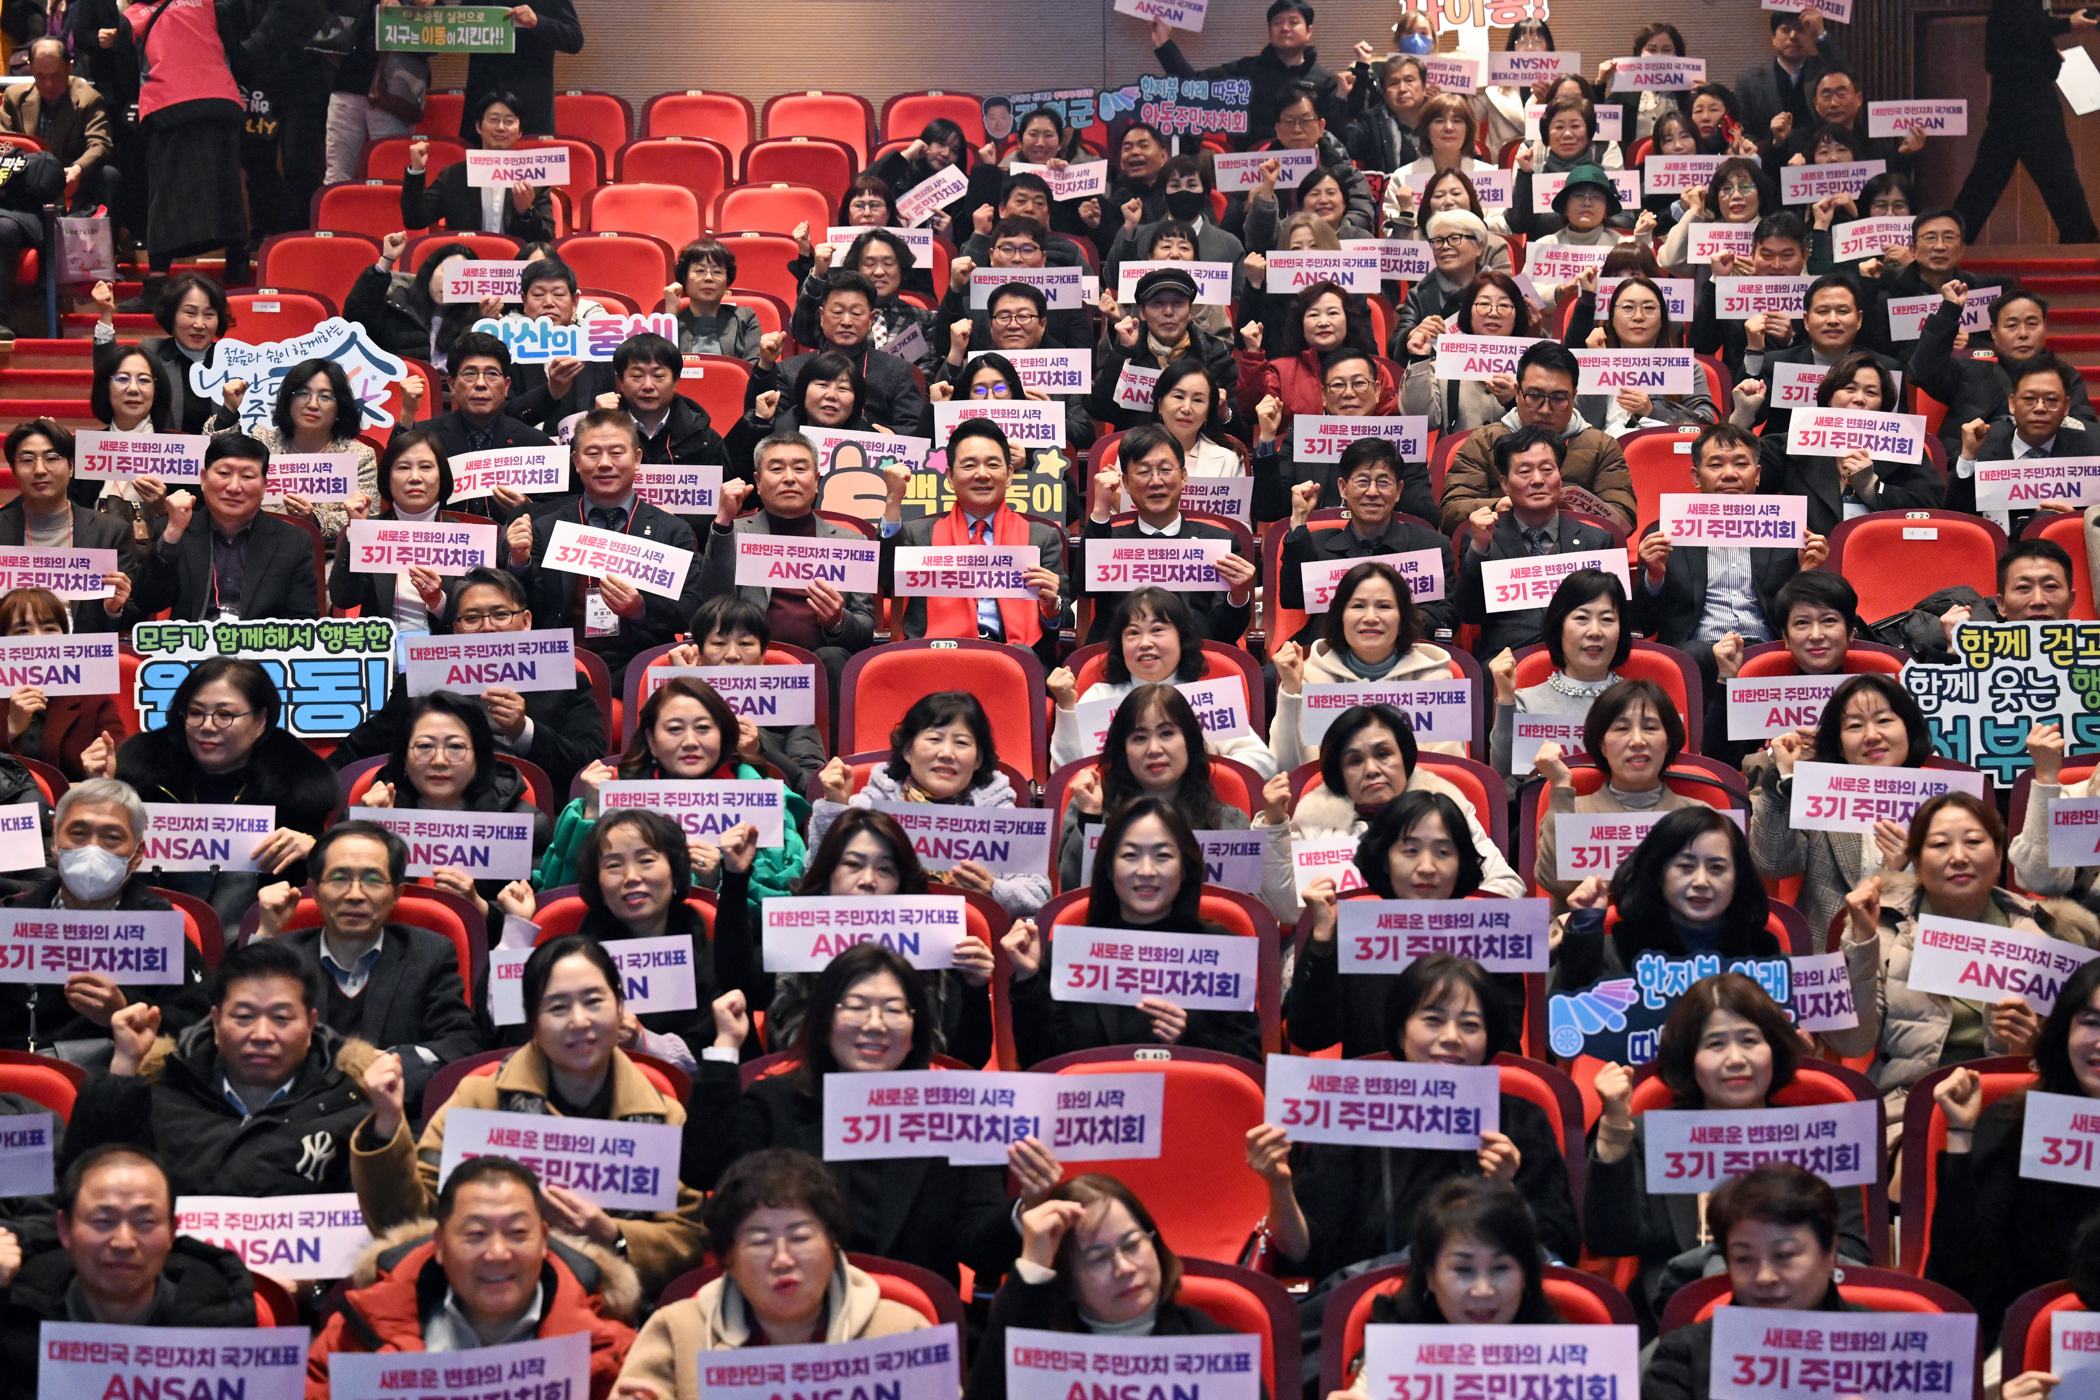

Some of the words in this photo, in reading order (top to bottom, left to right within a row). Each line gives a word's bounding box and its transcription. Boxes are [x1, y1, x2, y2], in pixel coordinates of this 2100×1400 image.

[1135, 2, 1184, 21] ANSAN
[385, 25, 420, 45] 지구는
[421, 26, 456, 46] 이동이
[457, 27, 504, 46] 지킨다!!
[1510, 58, 1560, 69] ANSAN
[1617, 63, 1643, 71] 대한민국
[1644, 63, 1672, 71] 주민자치
[1674, 63, 1701, 71] 국가대표
[1634, 73, 1684, 86] ANSAN
[1141, 75, 1177, 102] 한지붕
[1181, 80, 1208, 100] 아래
[1211, 79, 1251, 104] 따뜻한
[1141, 102, 1248, 135] 와동주민자치회
[1872, 107, 1902, 116] 대한민국
[1904, 106, 1933, 115] 주민자치
[1935, 106, 1963, 114] 국가대표
[1893, 117, 1944, 130] ANSAN
[470, 157, 501, 165] 대한민국
[503, 157, 533, 166] 주민자치
[535, 155, 566, 164] 국가대표
[492, 167, 545, 181] ANSAN
[1801, 171, 1824, 180] 새로운
[1826, 169, 1849, 179] 변화의
[1851, 168, 1867, 177] 시작
[1790, 183, 1812, 197] 3기
[1270, 259, 1303, 268] 대한민국
[1306, 259, 1340, 268] 주민자치
[1343, 259, 1377, 268] 국가대표
[974, 275, 1007, 285] 대한민국
[1046, 275, 1079, 284] 국가대표
[1292, 272, 1353, 285] ANSAN
[1737, 284, 1763, 294] 새로운
[1765, 284, 1790, 294] 변화의
[1792, 284, 1808, 293] 시작
[1725, 297, 1749, 312] 3기
[224, 347, 262, 366] 젊음과
[266, 347, 290, 363] 쉼이
[292, 324, 344, 356] 함께하는
[1020, 358, 1047, 367] 변화의
[1050, 357, 1068, 367] 시작
[1613, 357, 1650, 367] 주민자치
[1653, 357, 1690, 367] 국가대표
[1598, 372, 1664, 386] ANSAN
[959, 409, 990, 420] 새로운
[991, 409, 1019, 419] 변화의
[1022, 410, 1041, 420] 시작
[1814, 417, 1844, 427] 새로운
[1847, 418, 1877, 431] 변화의
[1879, 422, 1900, 433] 시작
[99, 441, 129, 452] 새로운
[132, 442, 161, 453] 변화의
[164, 444, 185, 454] 시작
[1798, 431, 1826, 447] 3기
[1830, 433, 1913, 455] 주민자치회
[84, 455, 112, 472] 3기
[116, 456, 198, 476] 주민자치회
[465, 459, 491, 471] 새로운
[494, 456, 522, 467] 변화의
[525, 455, 545, 465] 시작
[454, 474, 476, 493] 3기
[480, 468, 559, 488] 주민자치회
[1980, 469, 2021, 481] 대한민국
[2024, 467, 2065, 479] 주민자치
[2008, 482, 2081, 500] ANSAN
[1687, 504, 1720, 515] 새로운
[1723, 504, 1755, 516] 변화의
[1758, 505, 1780, 516] 시작
[1671, 519, 1702, 537] 3기
[1707, 520, 1795, 539] 주민자치회
[576, 535, 608, 550] 새로운
[610, 541, 641, 558] 변화의
[642, 546, 664, 563] 시작
[741, 543, 784, 556] 대한민국
[787, 546, 829, 559] 주민자치
[832, 549, 875, 562] 국가대표
[1113, 549, 1145, 560] 새로운
[1148, 549, 1179, 560] 변화의
[1182, 549, 1204, 560] 시작
[555, 546, 587, 565] 3기
[588, 552, 675, 588] 주민자치회
[922, 555, 954, 566] 새로운
[957, 555, 988, 567] 변화의
[991, 556, 1013, 567] 시작
[768, 562, 845, 581] ANSAN
[906, 571, 937, 588] 3기
[941, 571, 1029, 589] 주민자치회
[1097, 564, 1127, 582] 3기
[1132, 565, 1221, 583] 주민자치회
[138, 625, 206, 651] 모두가
[214, 624, 312, 652] 함께해서
[318, 623, 390, 651] 행복한
[410, 646, 461, 660] 대한민국
[464, 643, 515, 659] 주민자치
[518, 640, 569, 655] 국가대표
[1960, 628, 2027, 669] 함께
[446, 661, 536, 684] ANSAN
[1909, 671, 1977, 711] 함께
[1992, 669, 2056, 709] 웃는
[1828, 777, 1870, 793] 새로운
[1874, 779, 1916, 795] 변화의
[606, 793, 660, 807] 대한민국
[664, 793, 718, 807] 주민자치
[723, 793, 777, 807] 국가대표
[1806, 796, 1846, 820] 3기
[1377, 914, 1424, 930] 새로운
[1428, 913, 1474, 930] 변화의
[1478, 913, 1510, 929] 시작
[13, 923, 59, 939] 새로운
[63, 924, 109, 940] 변화의
[113, 925, 145, 941] 시작
[1355, 936, 1399, 961] 3기
[1922, 929, 1986, 955] 대한민국
[41, 945, 167, 972] 주민자치회
[1090, 943, 1134, 961] 새로운
[1138, 946, 1184, 964] 변화의
[1188, 949, 1219, 966] 시작
[1067, 964, 1109, 991] 3기
[1115, 967, 1240, 999] 주민자치회
[1308, 1075, 1360, 1095] 새로운
[1365, 1077, 1416, 1097] 변화의
[1421, 1080, 1457, 1099] 시작
[867, 1087, 919, 1106] 새로운
[924, 1087, 975, 1106] 변화의
[980, 1089, 1015, 1108] 시작
[1281, 1098, 1331, 1129] 3기
[1338, 1101, 1481, 1135] 주민자치회
[843, 1114, 891, 1143] 3기
[899, 1112, 1039, 1144] 주민자치회
[1763, 1328, 1824, 1351] 새로운
[1830, 1331, 1887, 1352] 변화의
[1891, 1331, 1928, 1352] 시작
[48, 1340, 129, 1366] 대한민국
[134, 1345, 216, 1368] 주민자치
[222, 1345, 300, 1368] 국가대표
[1732, 1355, 1790, 1390] 3기
[1799, 1359, 1953, 1394] 주민자치회
